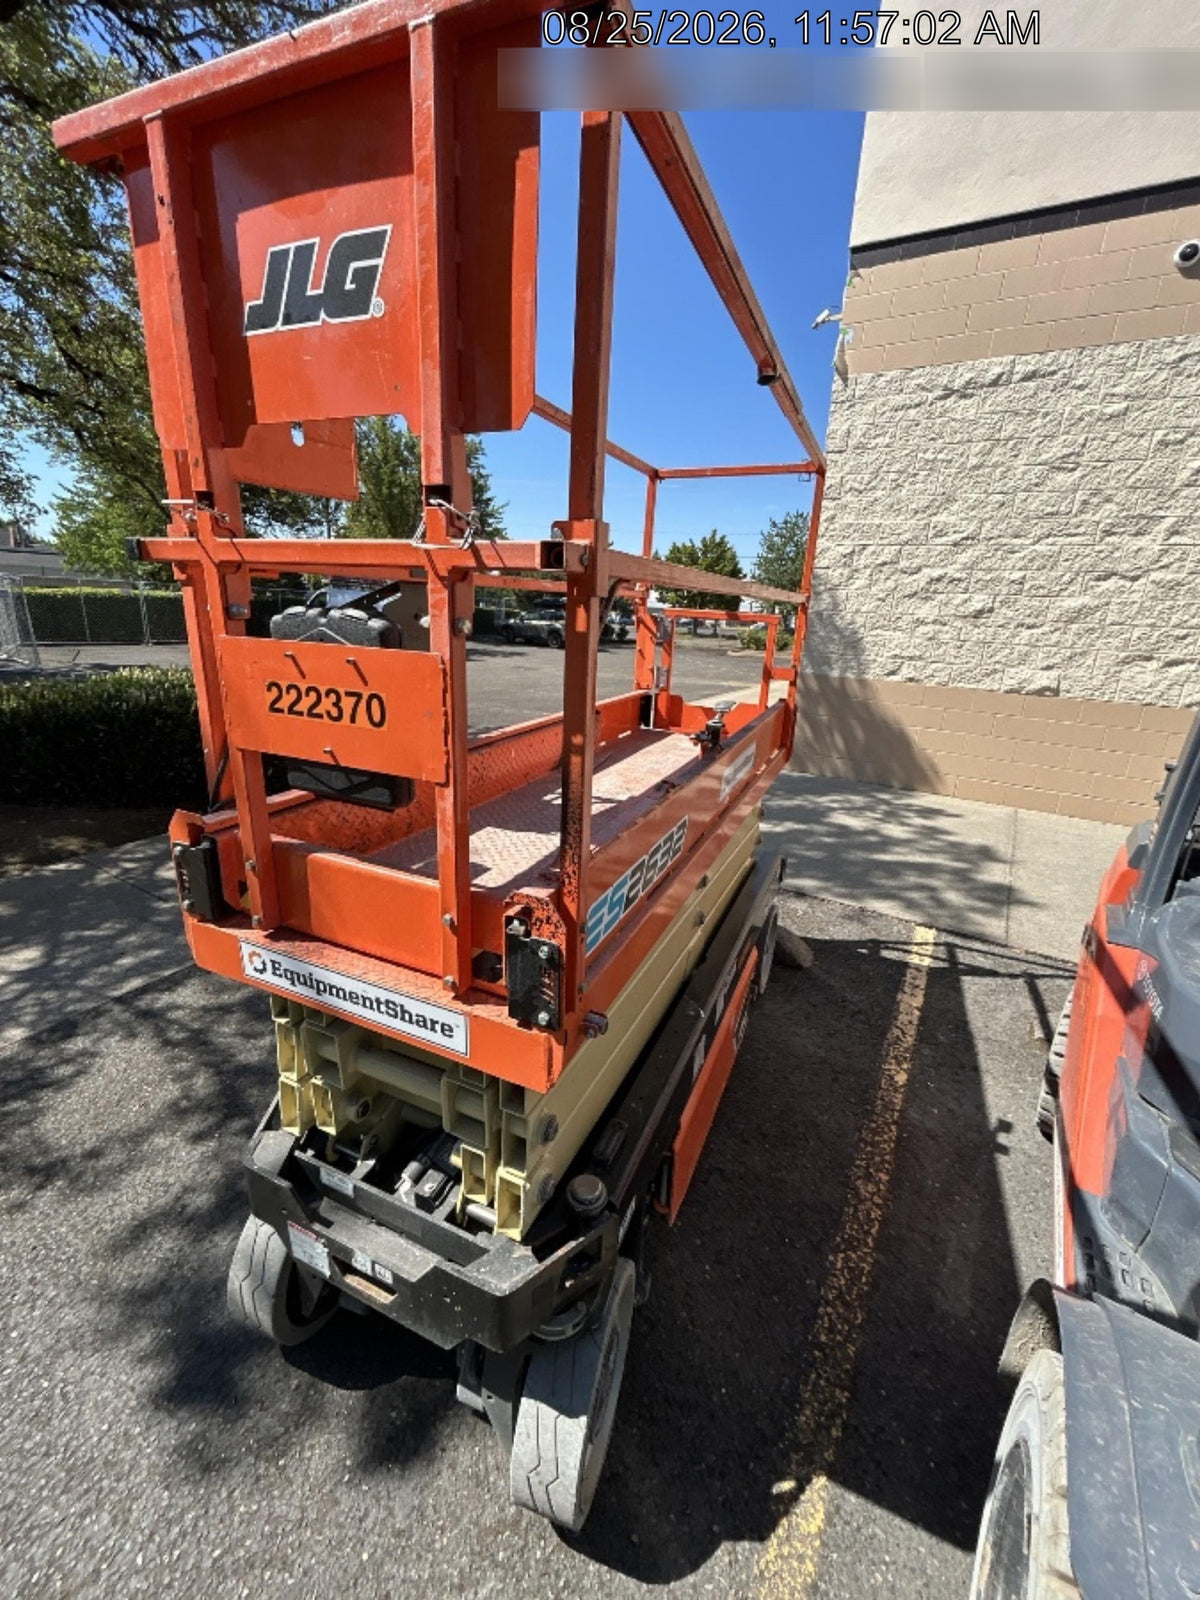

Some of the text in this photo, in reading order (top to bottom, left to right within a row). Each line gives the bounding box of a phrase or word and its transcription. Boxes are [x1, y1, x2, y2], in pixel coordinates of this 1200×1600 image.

[243, 224, 393, 336] JLG
[265, 680, 387, 729] 222370
[585, 814, 690, 959] ES2632
[269, 958, 455, 1040] EquipmentShare
